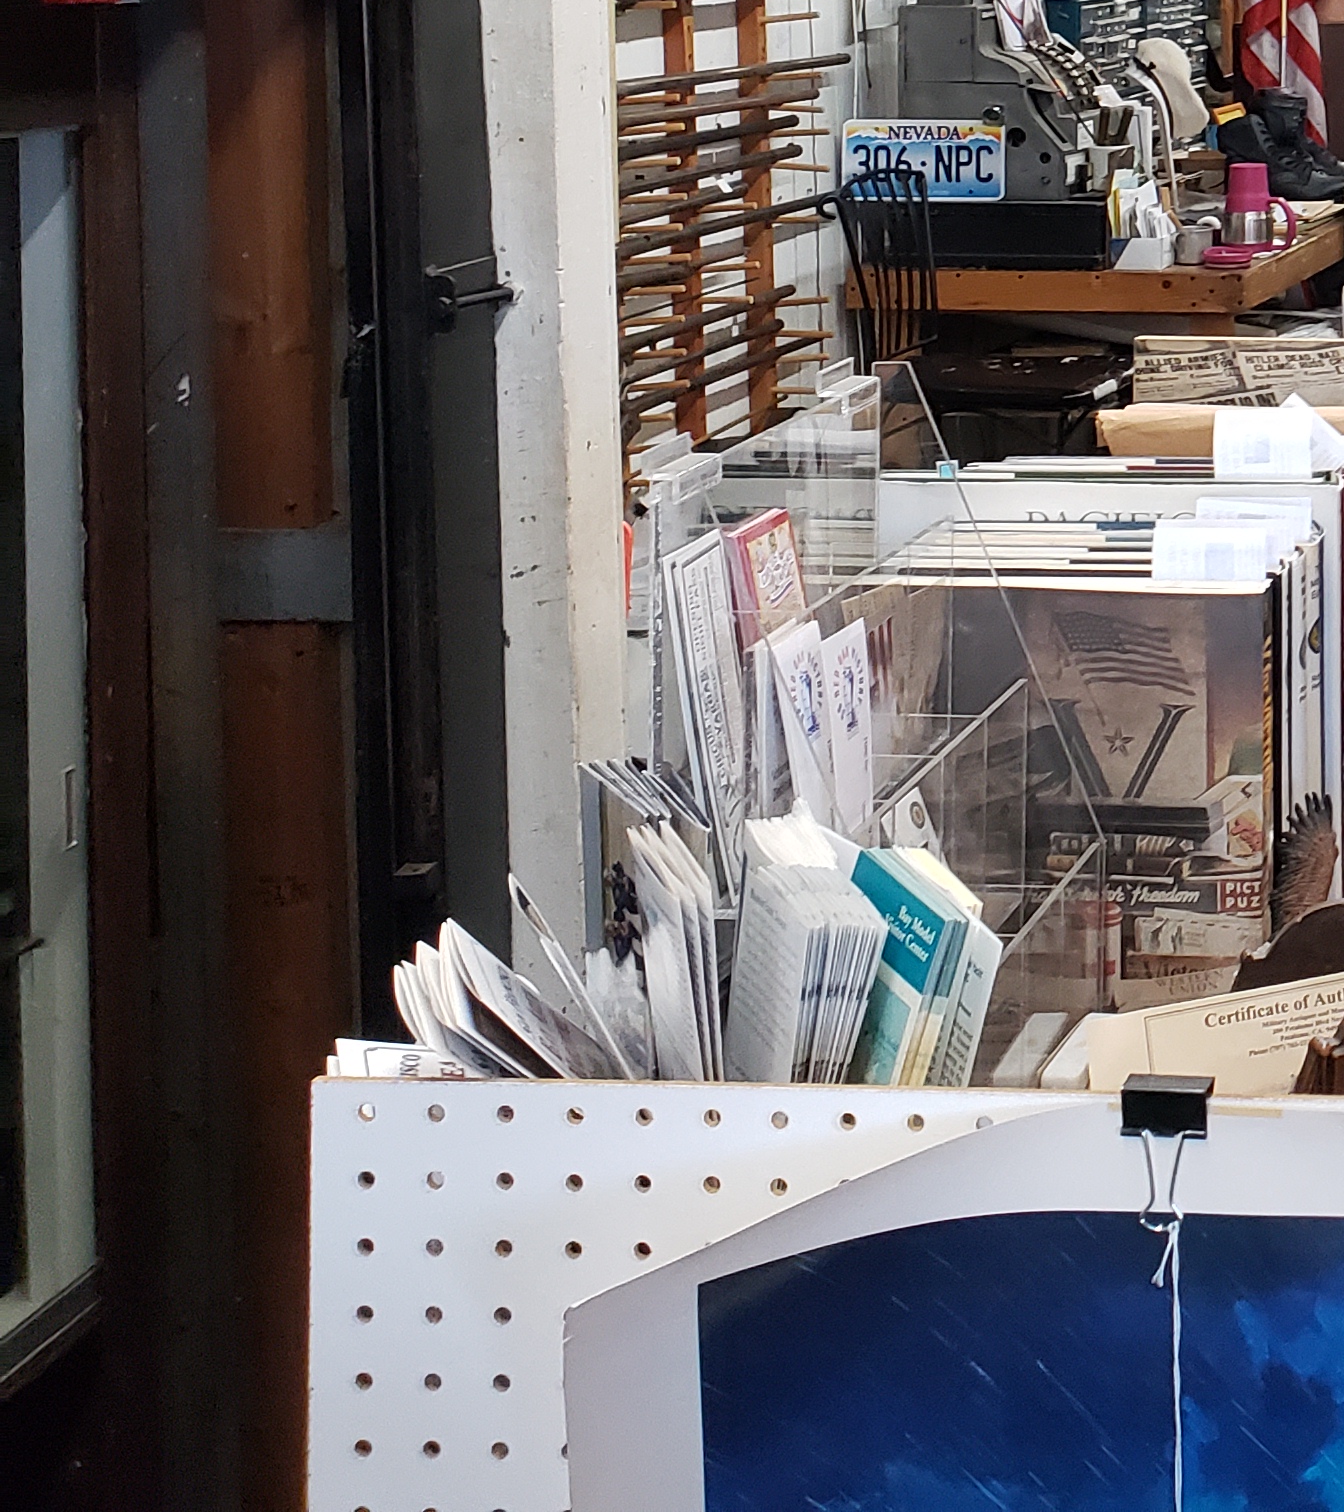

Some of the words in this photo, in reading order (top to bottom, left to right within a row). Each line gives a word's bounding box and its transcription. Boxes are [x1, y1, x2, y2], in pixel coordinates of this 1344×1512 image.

[887, 125, 963, 140] NEVADA
[852, 144, 912, 183] 306
[935, 145, 994, 183] NPC
[1144, 355, 1184, 367] ALLIED
[1245, 353, 1281, 366] HITLER
[1285, 352, 1314, 364] DEAD,
[1225, 881, 1261, 894] PICT
[1225, 896, 1261, 909] PUZ
[898, 905, 913, 928] Bay
[912, 916, 937, 945] Model
[905, 933, 929, 963] Center
[1204, 1005, 1290, 1028] Certificate
[1293, 995, 1310, 1011] of
[1262, 1017, 1287, 1029] Military
